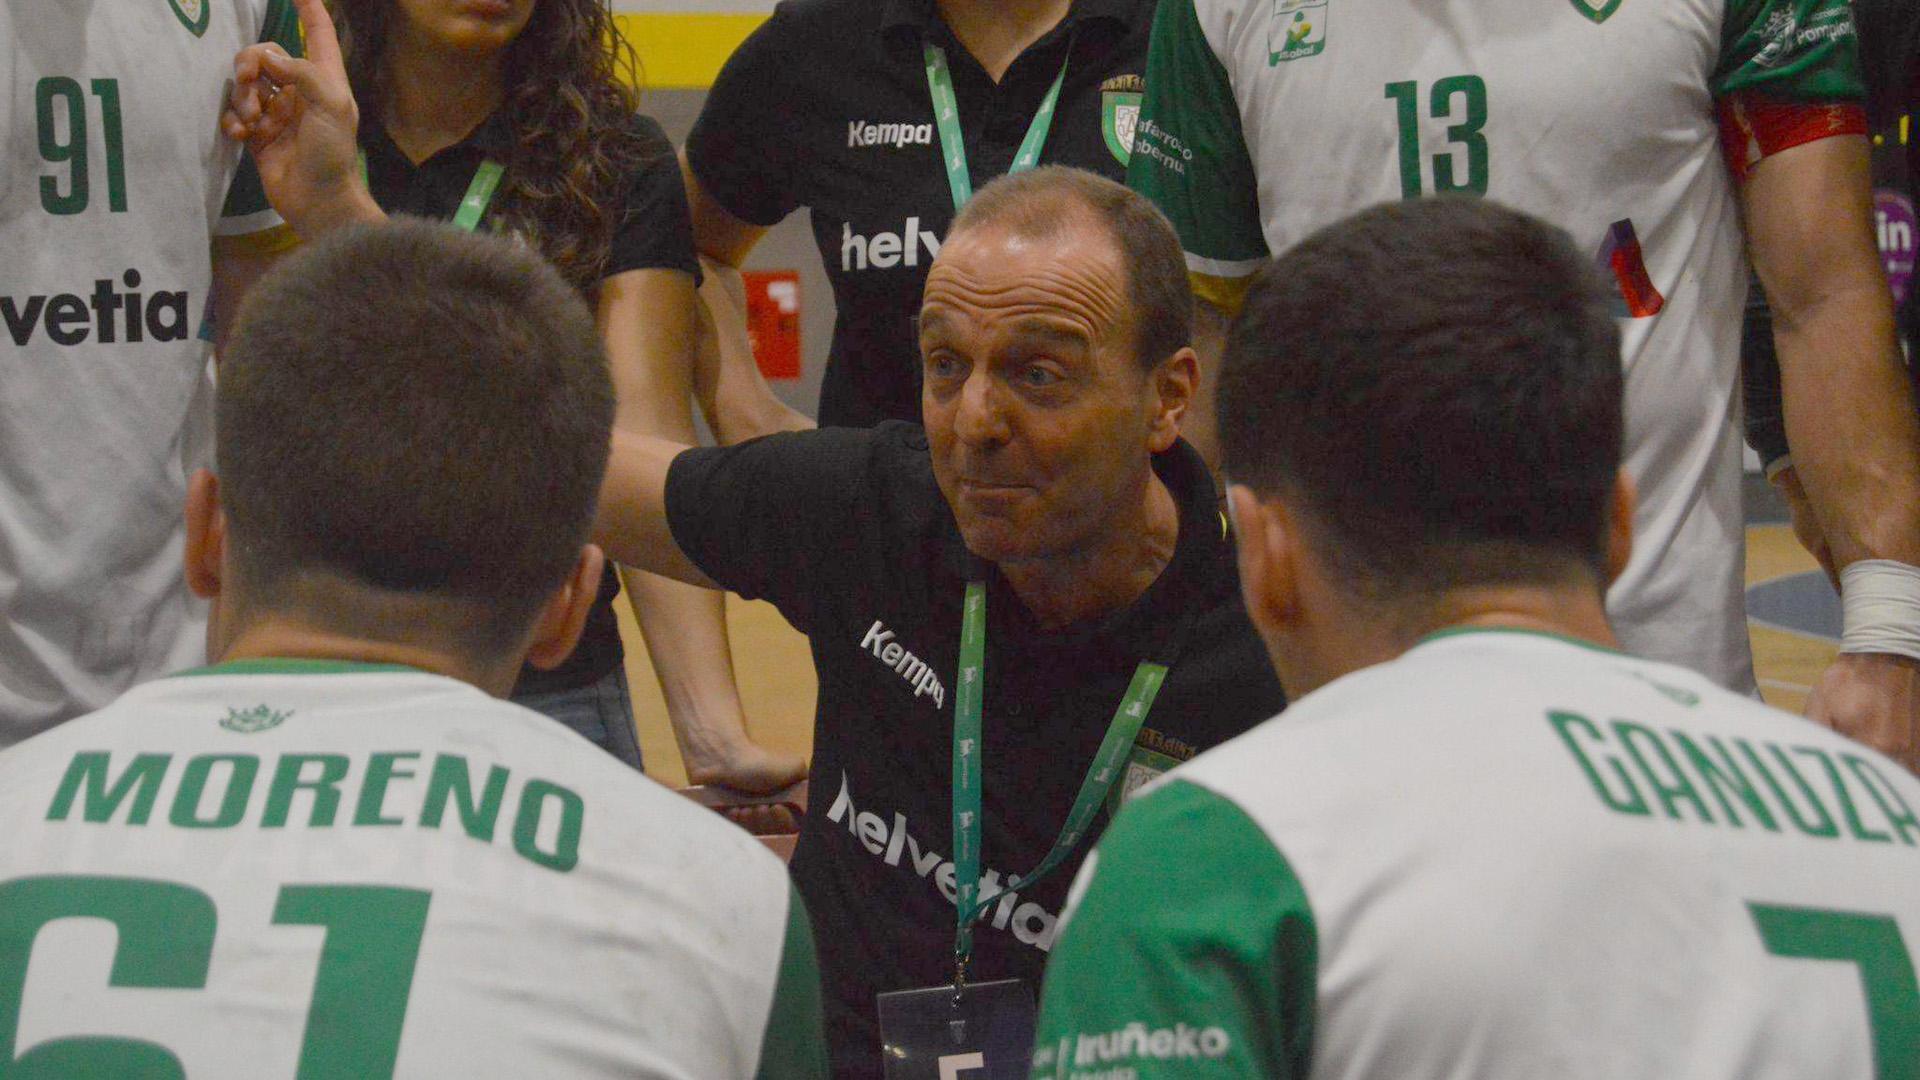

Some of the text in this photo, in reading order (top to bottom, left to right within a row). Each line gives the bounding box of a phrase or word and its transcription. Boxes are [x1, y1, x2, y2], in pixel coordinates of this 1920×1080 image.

[35, 76, 128, 215] 91
[848, 120, 932, 148] Kempa
[1384, 74, 1489, 200] 13
[0, 268, 188, 346] vetia
[860, 620, 944, 709] Kempa
[45, 750, 585, 873] MORENO
[1546, 709, 1920, 848] GANUZA
[0, 873, 433, 1080] 61
